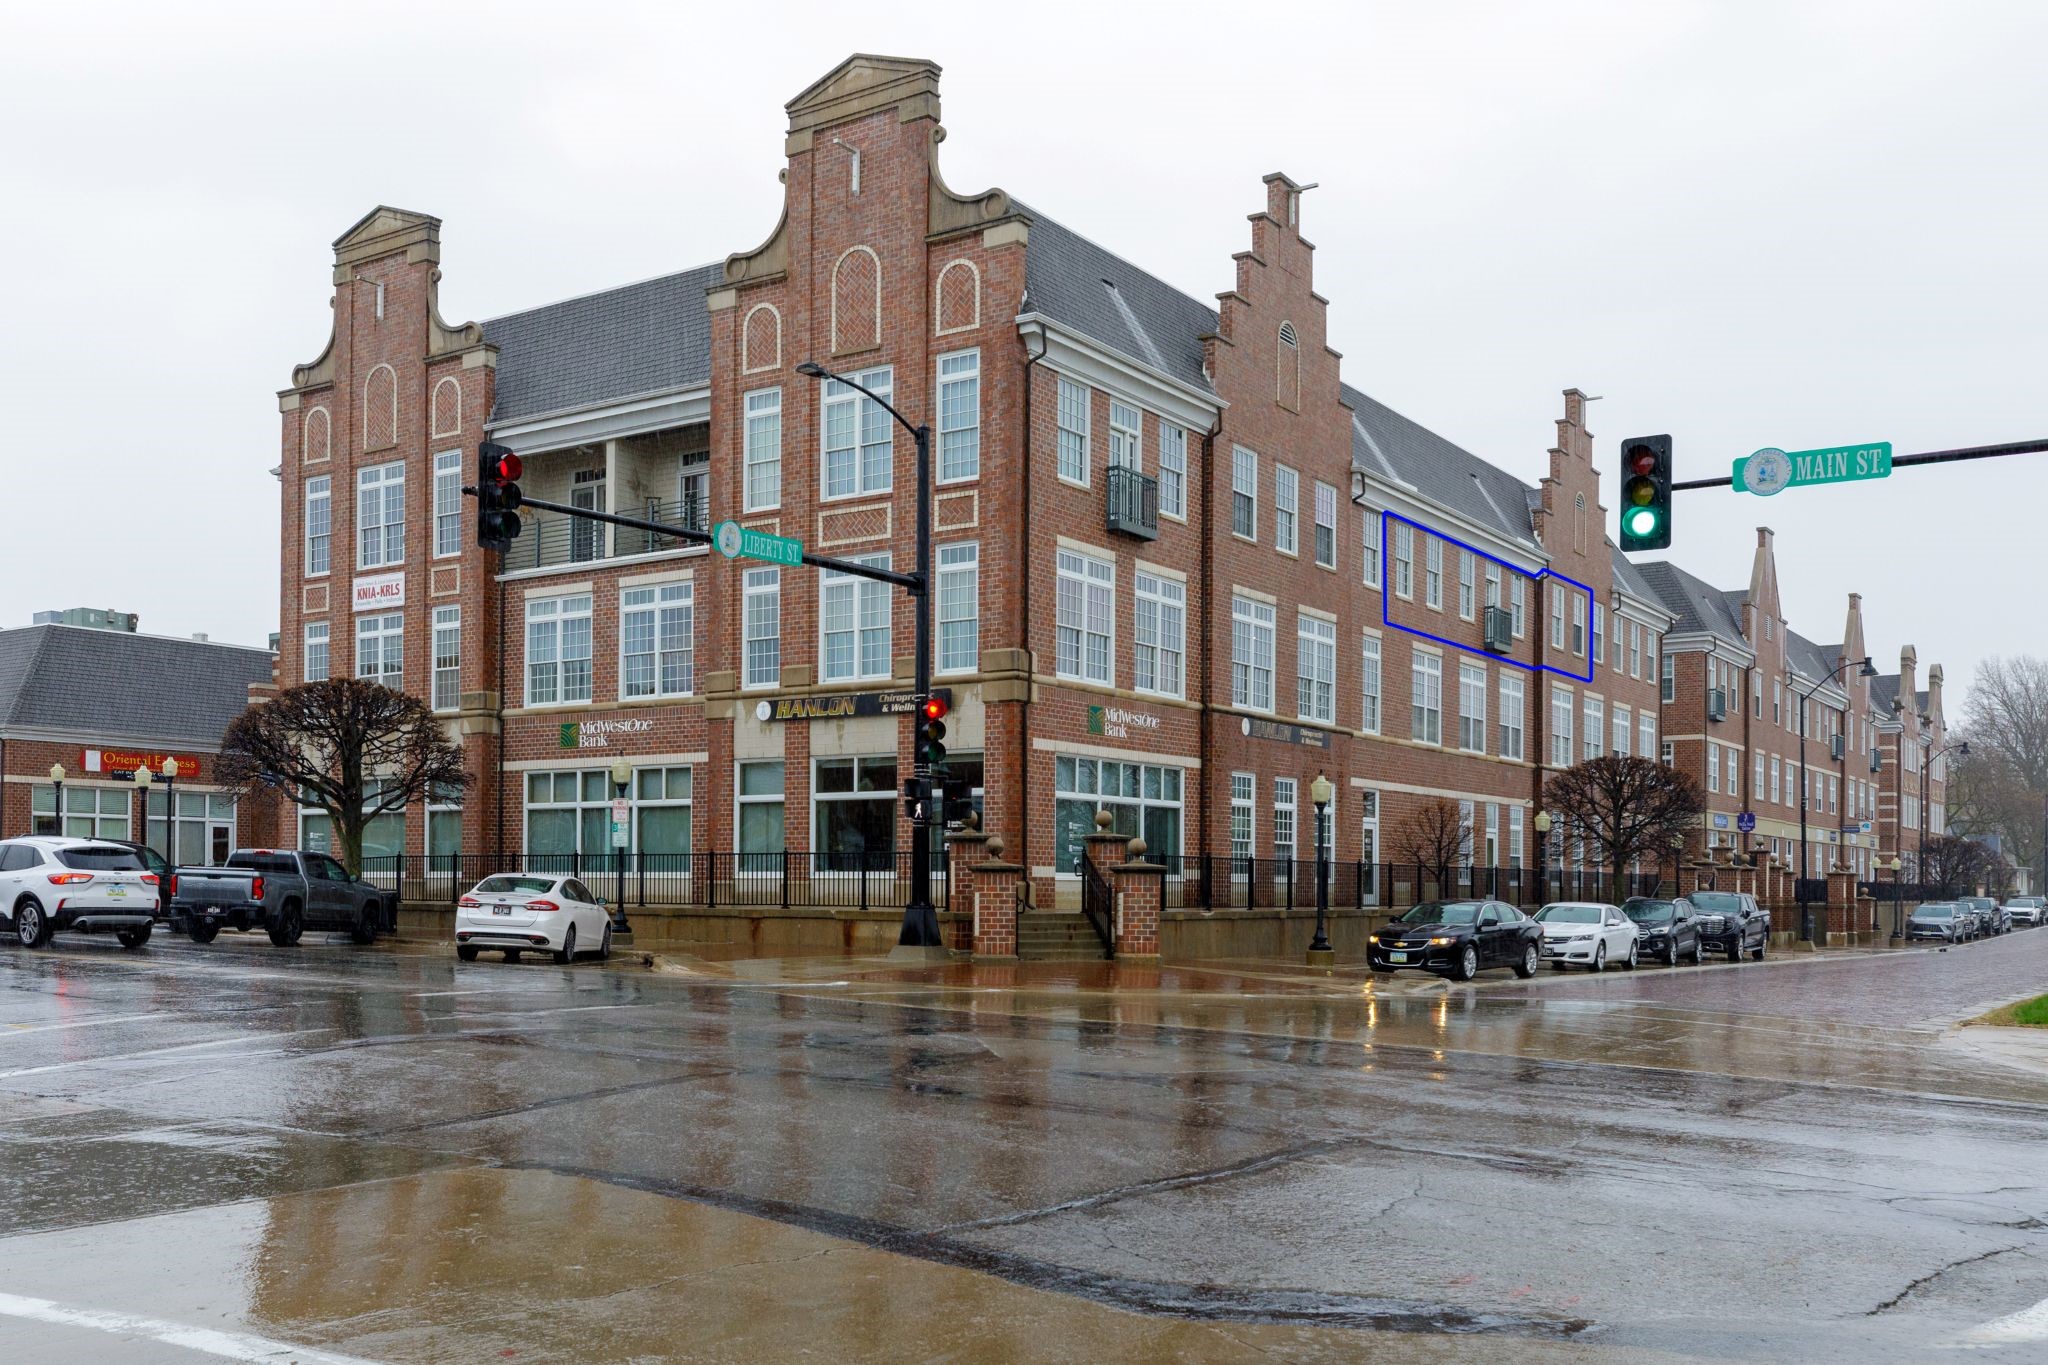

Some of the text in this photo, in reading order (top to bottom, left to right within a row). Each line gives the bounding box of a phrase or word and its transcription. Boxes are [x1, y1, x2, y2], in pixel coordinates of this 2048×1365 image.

[1796, 452, 1848, 480] MAIN
[1856, 449, 1884, 475] ST.
[744, 534, 783, 559] LIBERTY
[879, 693, 934, 703] Chiroprac
[776, 696, 857, 719] HANLON
[882, 704, 889, 713] &
[1105, 707, 1160, 728] MidWestOne
[580, 718, 653, 734] MidWestOne
[1104, 722, 1127, 738] Bank
[580, 733, 608, 747] Bank
[103, 752, 196, 768] Oriental Eess
